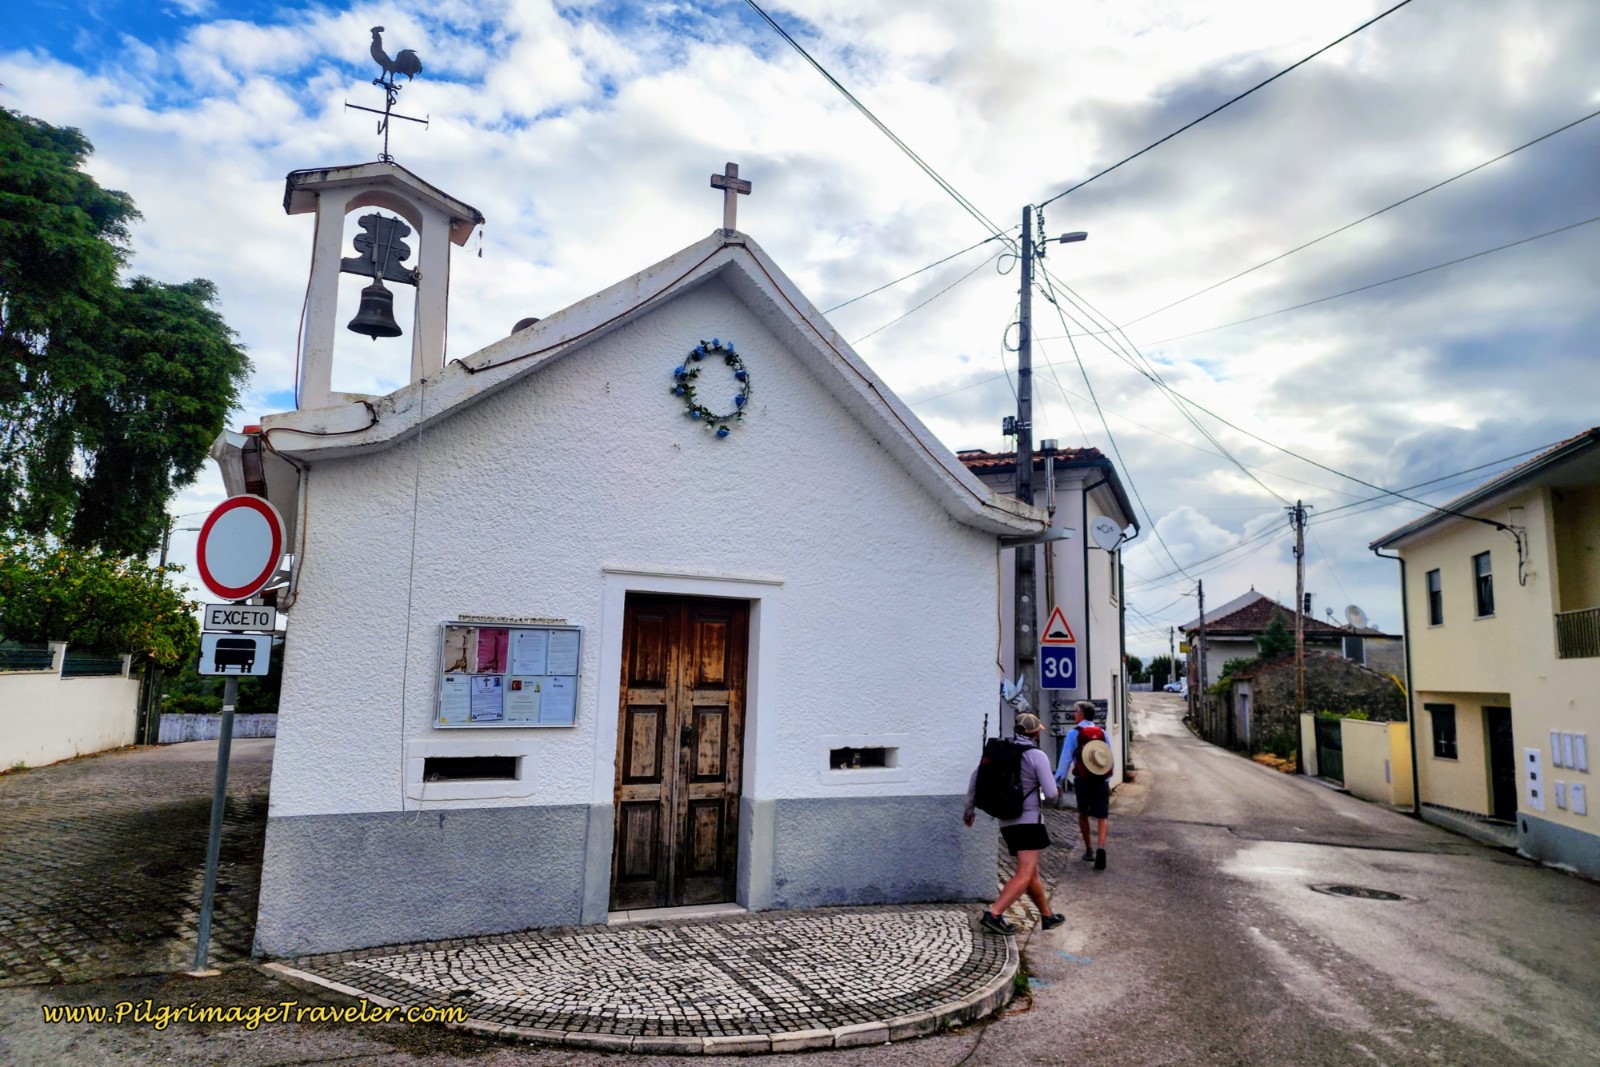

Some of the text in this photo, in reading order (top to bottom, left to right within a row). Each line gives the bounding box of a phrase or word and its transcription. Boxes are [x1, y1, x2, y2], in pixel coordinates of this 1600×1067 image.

[1096, 524, 1114, 533] NOS
[211, 609, 269, 626] EXCETO
[1045, 657, 1072, 678] 30
